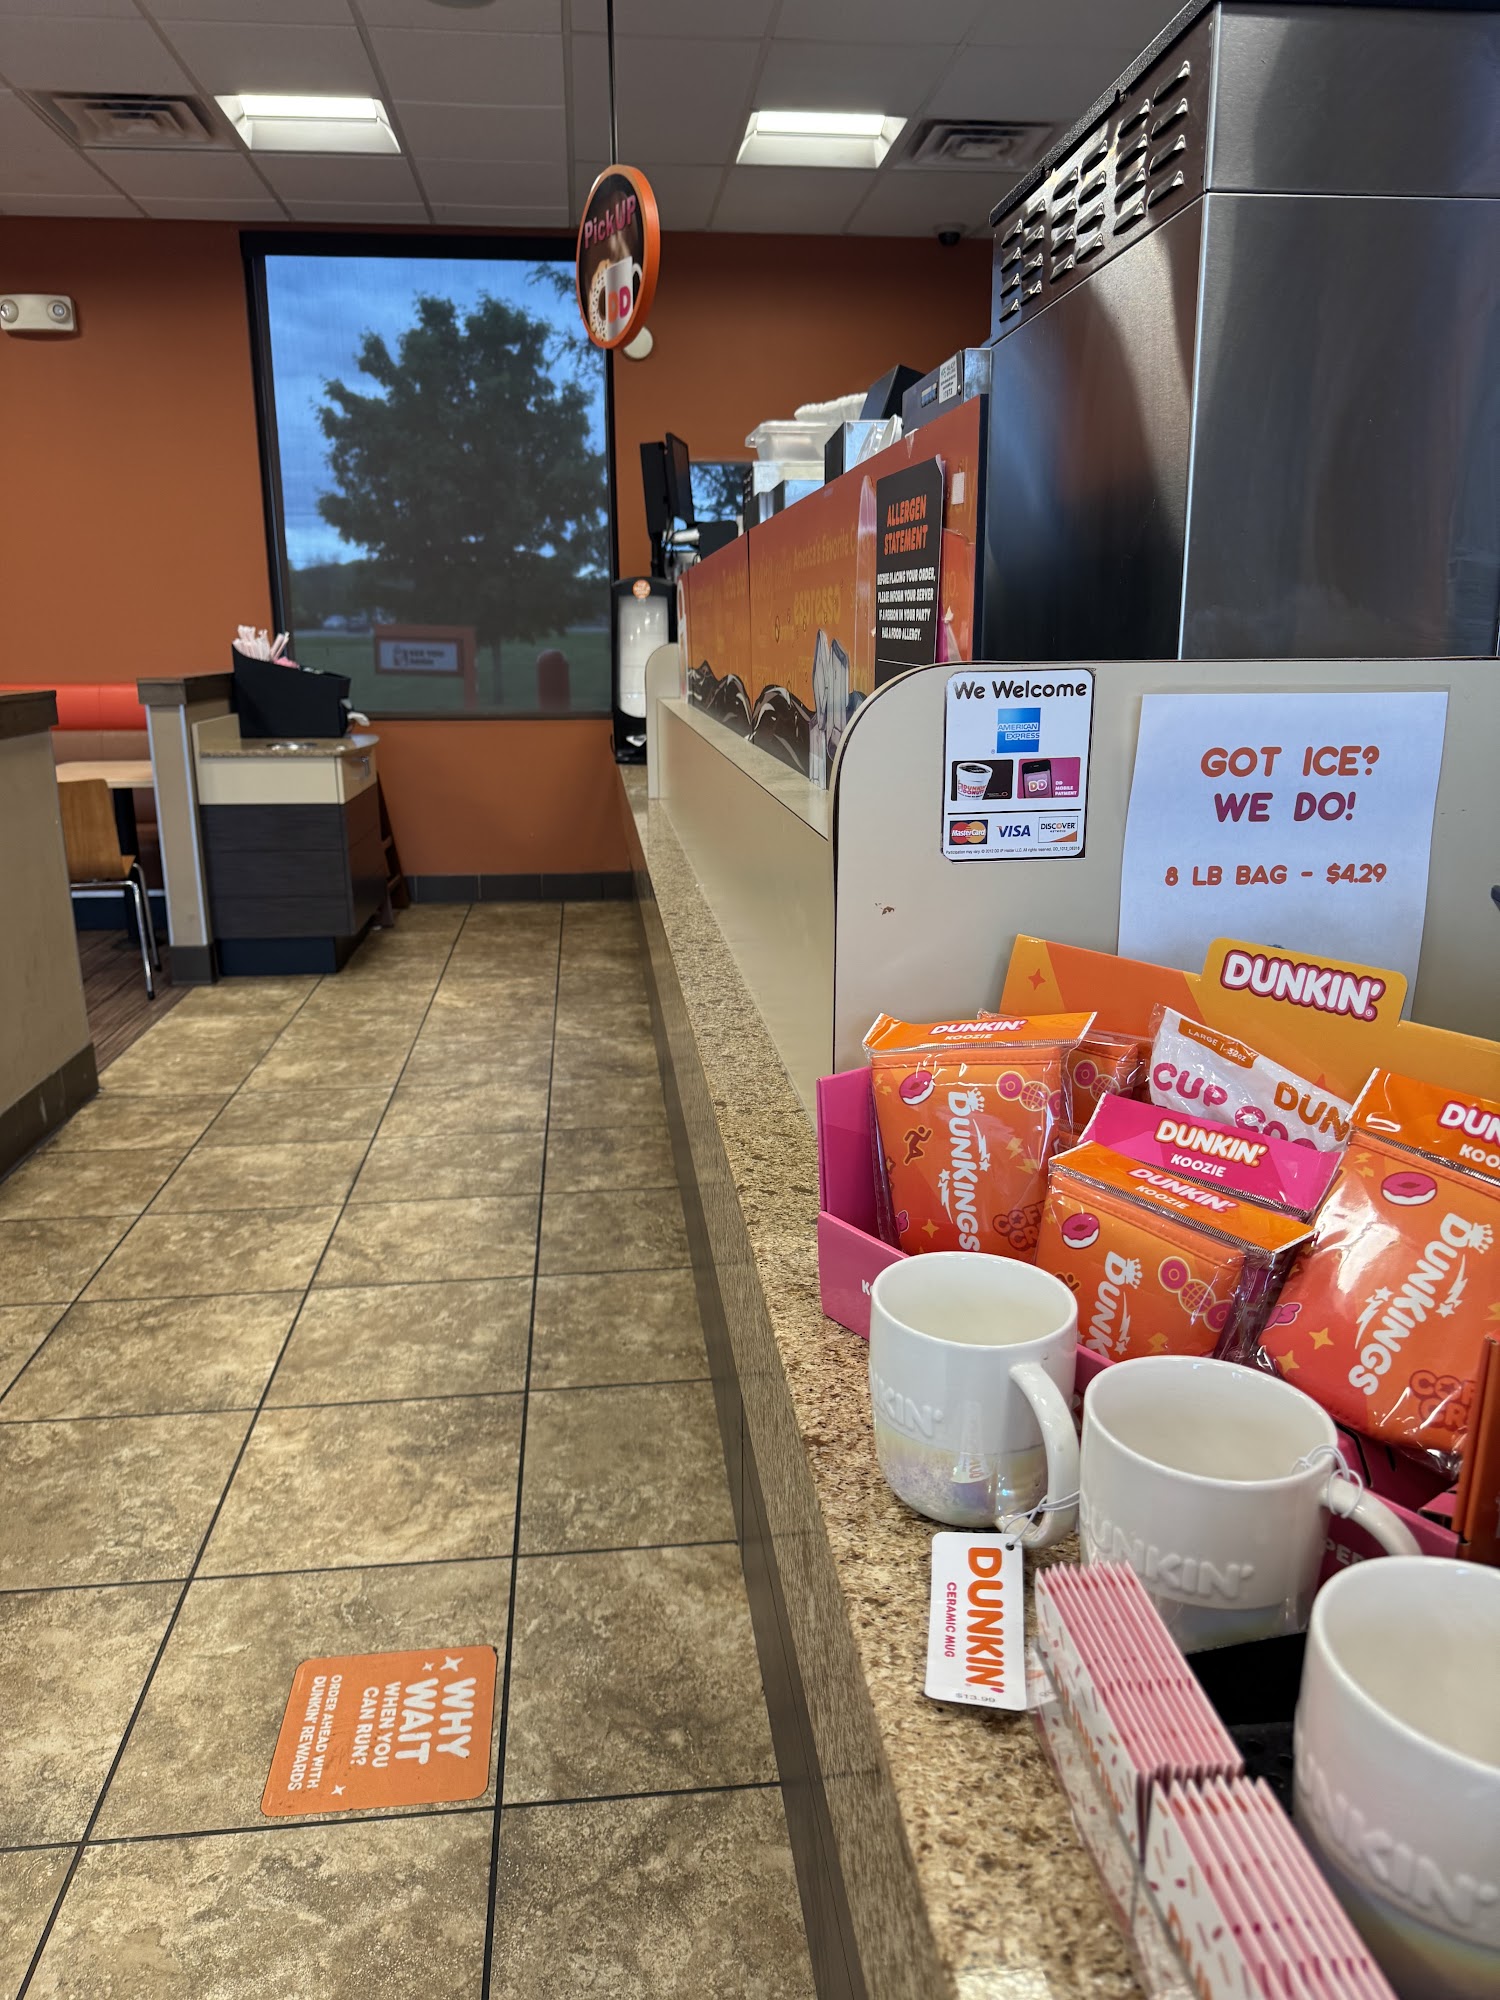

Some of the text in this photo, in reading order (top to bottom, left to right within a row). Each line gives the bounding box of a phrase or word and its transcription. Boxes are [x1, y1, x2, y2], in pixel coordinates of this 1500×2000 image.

[607, 285, 631, 324] DD
[887, 493, 927, 528] ALLERGEN
[884, 524, 928, 556] STATEMENT
[890, 570, 906, 585] PLACING
[906, 568, 918, 582] YOUR
[918, 566, 936, 582] ORDER,
[904, 588, 917, 602] YOUR
[916, 587, 934, 602] SERVER
[898, 608, 904, 621] IN
[903, 608, 916, 622] YOUR
[915, 607, 931, 622] PARTY
[901, 627, 922, 642] ALLERGY.
[953, 680, 1087, 700] We Welcome
[997, 723, 1039, 732] AMERICAN
[1005, 732, 1040, 740] EXPRESS
[1200, 745, 1380, 778] GOT ICE?
[1028, 779, 1048, 792] DD
[1213, 791, 1357, 823] WE DO!
[951, 829, 986, 837] MasterCard
[996, 825, 1031, 838] VISA
[1040, 822, 1075, 830] DISCOVER
[1164, 866, 1179, 887] 8
[1192, 865, 1223, 886] LB
[1235, 864, 1288, 886] BAG
[1326, 862, 1387, 885] $4.29
[1222, 952, 1383, 1017] DUNKIN'
[930, 1018, 1028, 1036] DUNKIN'
[944, 1033, 994, 1041] KOOZIE
[1187, 1028, 1219, 1047] LARGE
[1152, 1062, 1318, 1151] CUP CO
[1155, 1118, 1268, 1166] DUNKIN'
[1458, 1143, 1500, 1171] KOO
[948, 1089, 982, 1252] DUNKINGS
[1170, 1153, 1227, 1178] KOOZIE
[1128, 1168, 1239, 1213] DUNKIN'
[1134, 1185, 1190, 1210] KOOZIE
[1349, 1212, 1474, 1395] DUNKINGS
[943, 1581, 958, 1658] CERAMIC MUG
[965, 1547, 1005, 1694] DUNKIN'
[955, 1691, 996, 1703] $13.99
[306, 1674, 343, 1789] ORDER AHEAD WITH
[350, 1686, 380, 1766] CAN RUN?
[371, 1681, 402, 1768] WHEN YOU
[395, 1677, 440, 1765] WAIT
[435, 1677, 477, 1759] WHY
[287, 1675, 328, 1792] DUNKIN' REWARDS
